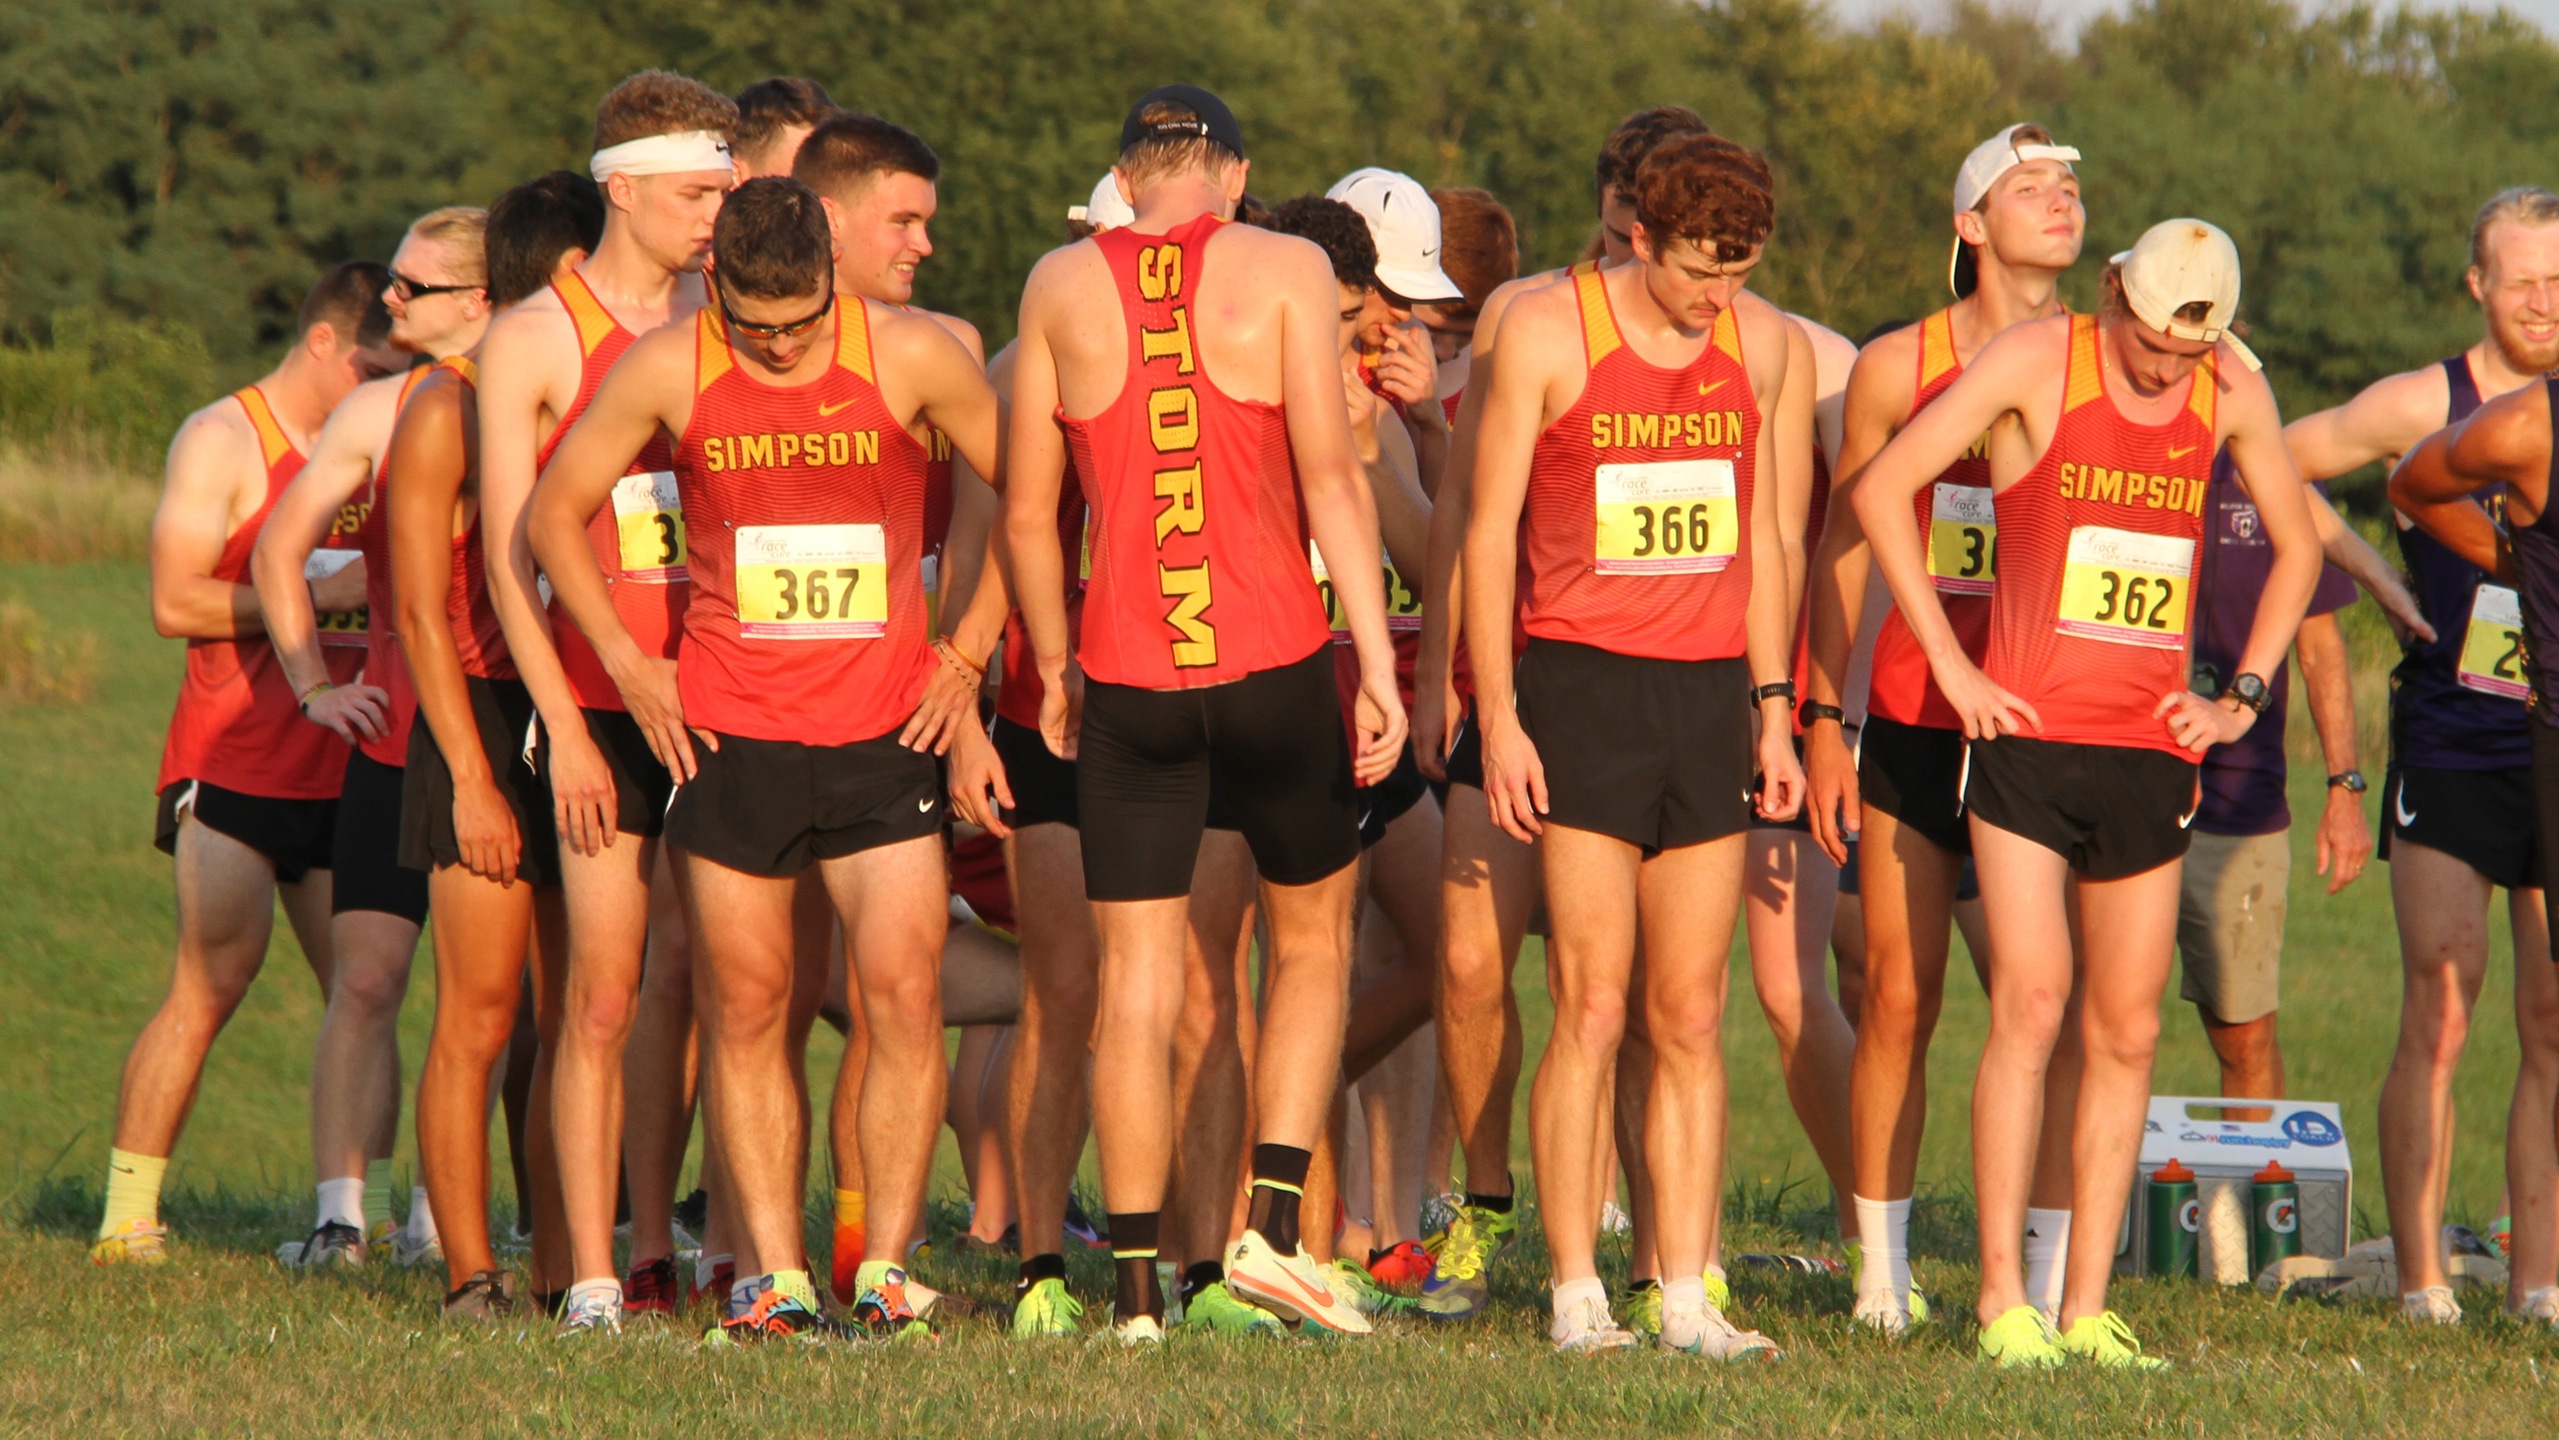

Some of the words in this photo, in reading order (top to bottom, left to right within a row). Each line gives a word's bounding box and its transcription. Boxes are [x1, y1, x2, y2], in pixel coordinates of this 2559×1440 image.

[1591, 410, 1743, 449] SIMPSON
[703, 430, 880, 473] SIMPSON
[1137, 242, 1219, 670] STORM
[1622, 480, 1648, 488] race
[2059, 462, 2206, 518] SIMPSON
[1954, 501, 1980, 511] race
[653, 511, 686, 565] 3
[761, 542, 788, 552] race
[1633, 503, 1709, 557] 366
[1960, 526, 1997, 577] 3
[2093, 542, 2119, 553] race
[774, 568, 859, 621] 367
[2095, 571, 2173, 628] 362
[2293, 1133, 2335, 1142] COACH
[2266, 1198, 2297, 1234] G
